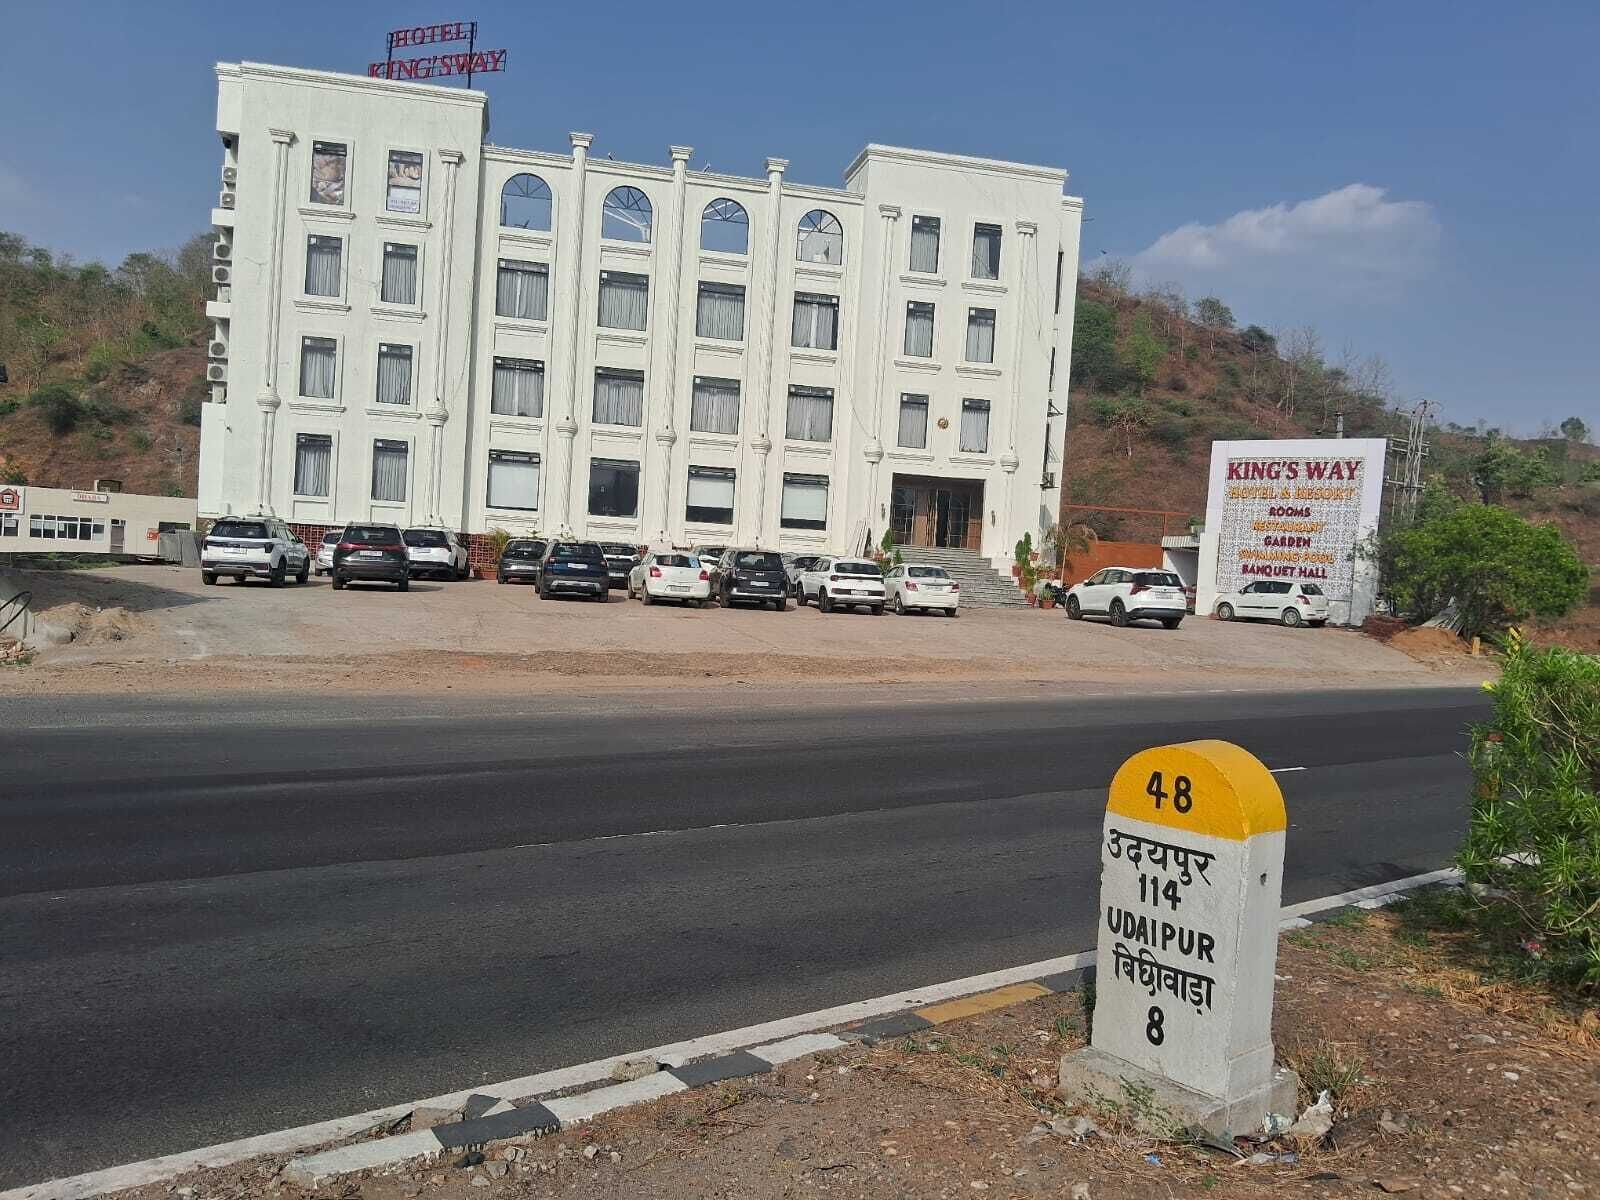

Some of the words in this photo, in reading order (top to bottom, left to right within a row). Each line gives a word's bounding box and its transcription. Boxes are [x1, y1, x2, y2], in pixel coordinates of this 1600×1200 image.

[395, 23, 467, 48] HOTEL
[1227, 461, 1299, 480] KING'S
[1306, 461, 1362, 480] WAY
[1269, 506, 1311, 518] ROOMS
[1264, 535, 1311, 548] GARDEN
[1242, 564, 1296, 578] BANQUET
[1299, 566, 1328, 579] HALL
[1146, 771, 1192, 814] 48
[1107, 828, 1216, 886] उदयपुर
[1139, 873, 1181, 911] 114
[1107, 906, 1215, 964] UDAIPUR
[1146, 1005, 1164, 1046] 8
